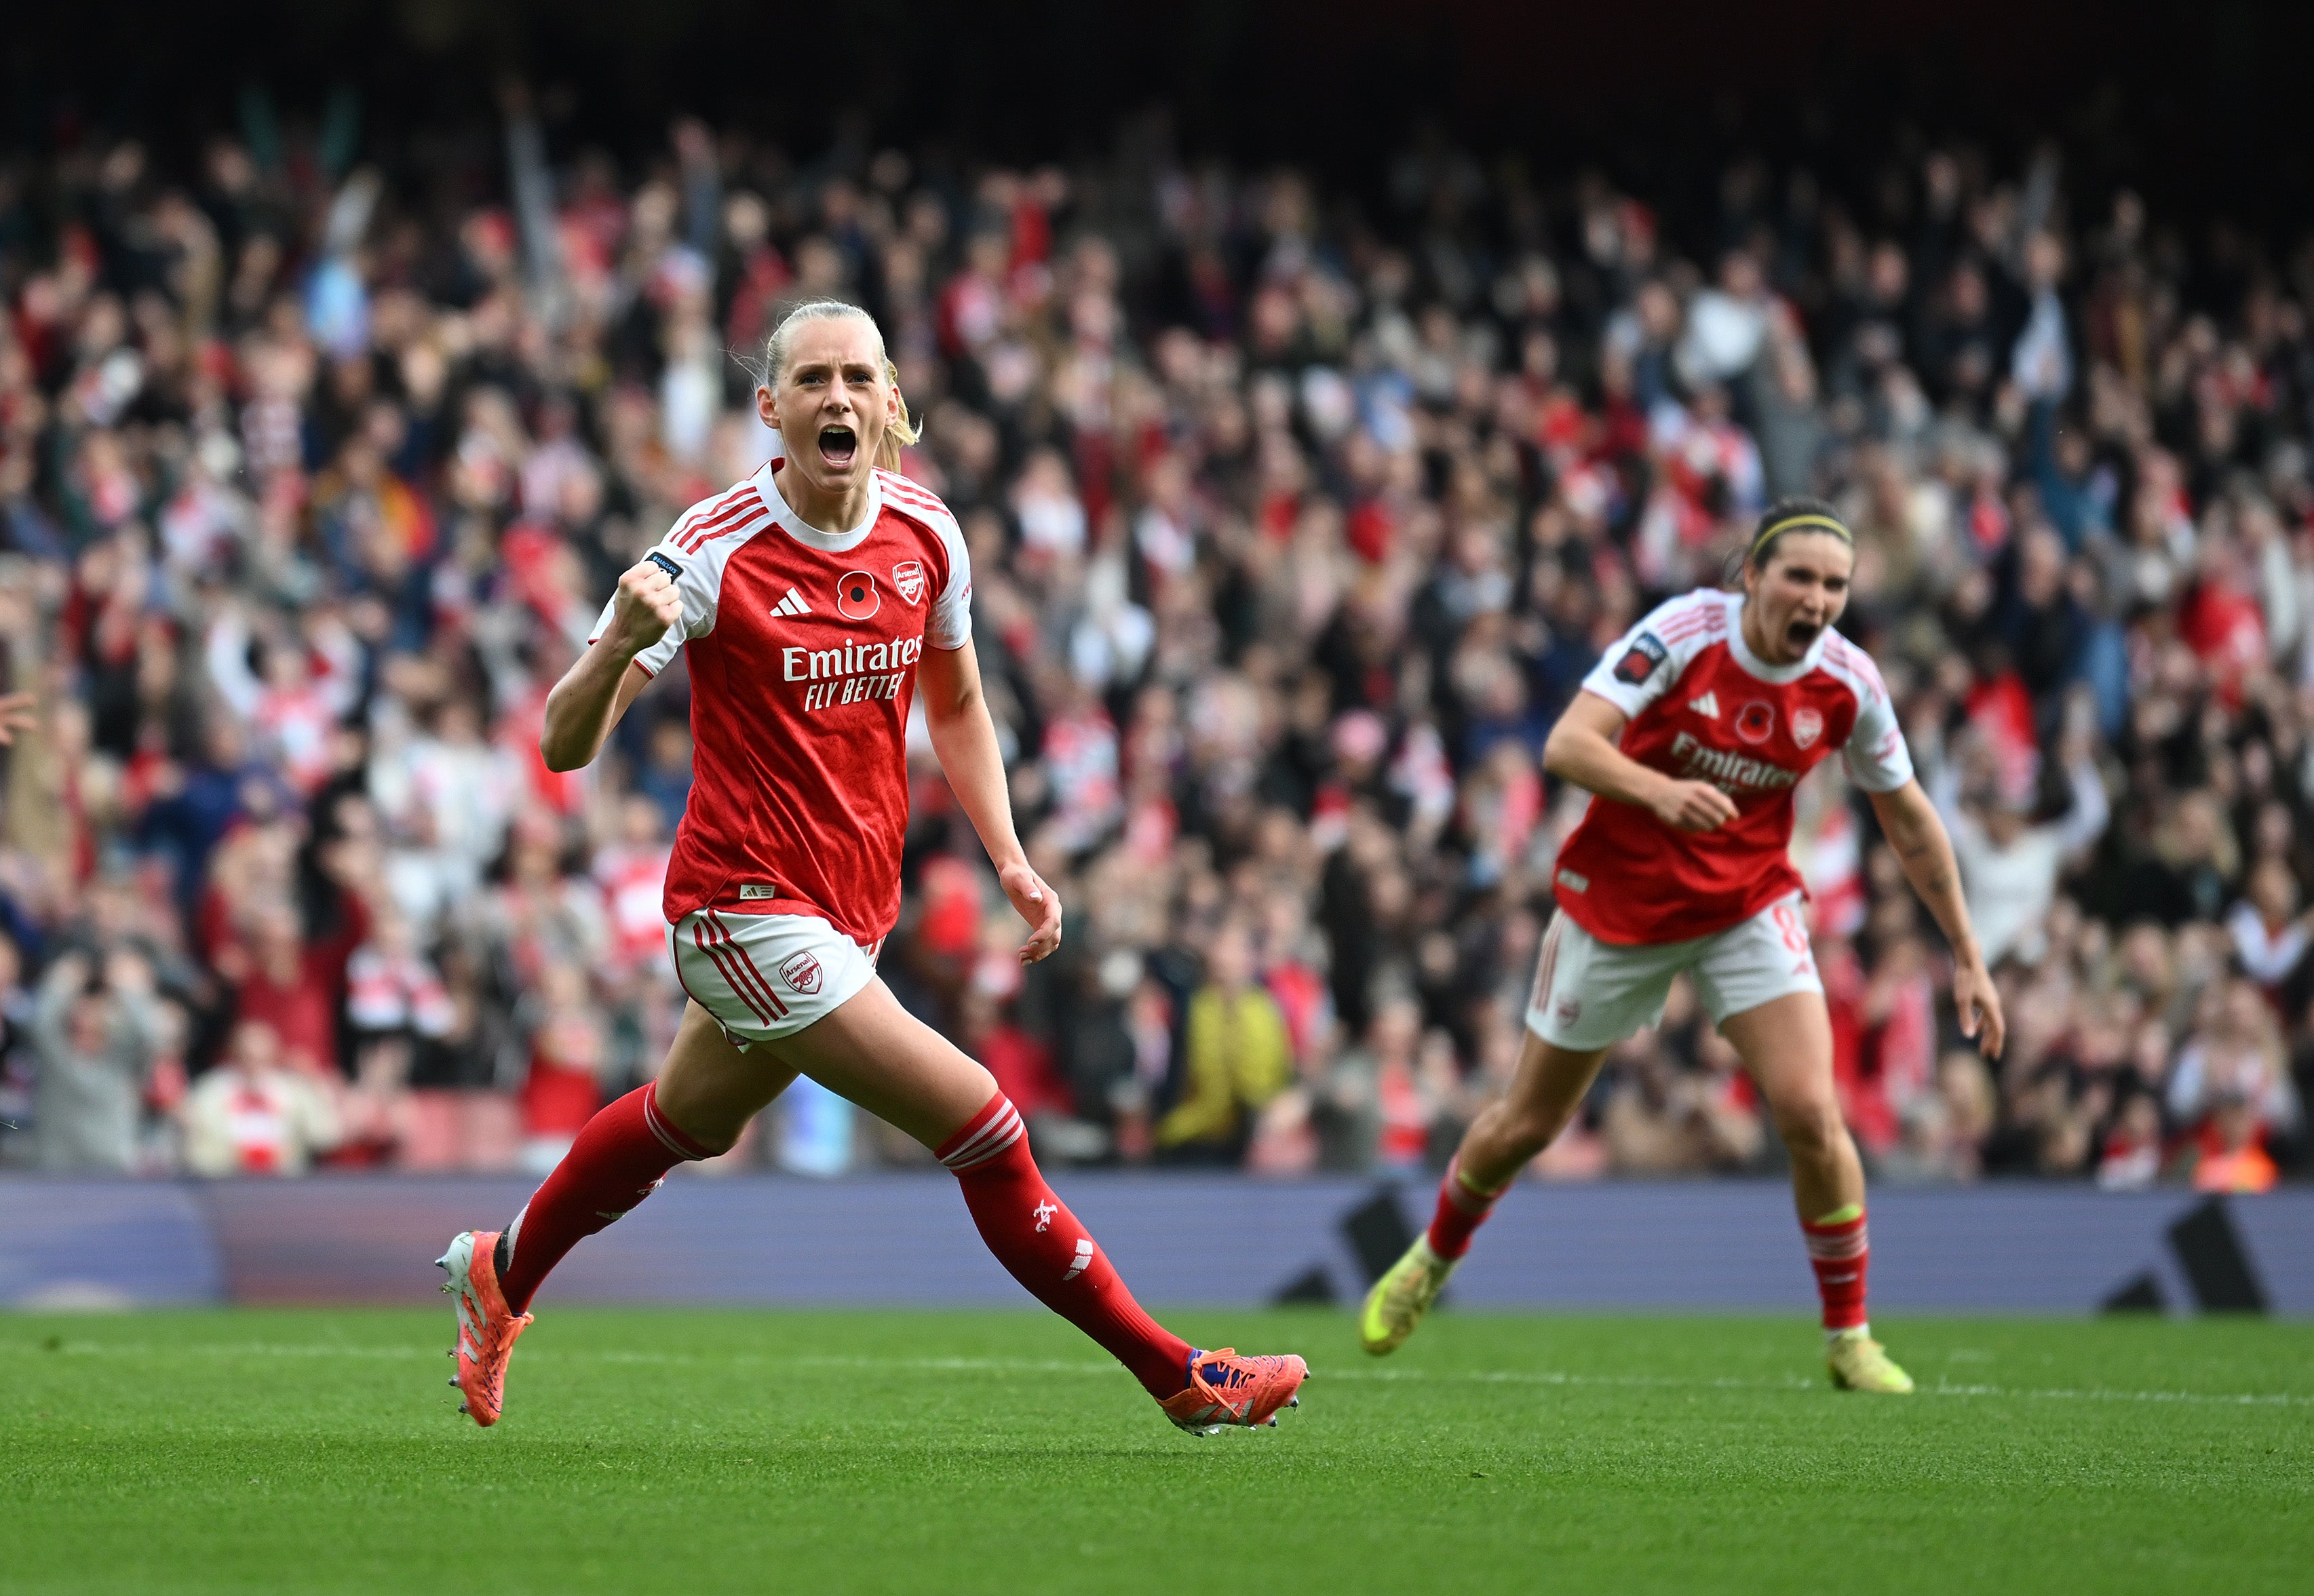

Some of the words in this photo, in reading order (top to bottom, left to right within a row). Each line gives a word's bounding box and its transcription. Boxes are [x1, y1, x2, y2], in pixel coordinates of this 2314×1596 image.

[656, 558, 678, 574] BARCLAYS
[898, 568, 919, 579] Arsenal
[782, 635, 923, 682] Emirates
[805, 682, 838, 712] FLY
[841, 671, 906, 705] BETTER
[1773, 906, 1807, 954] 8
[786, 957, 811, 977] Arsenal
